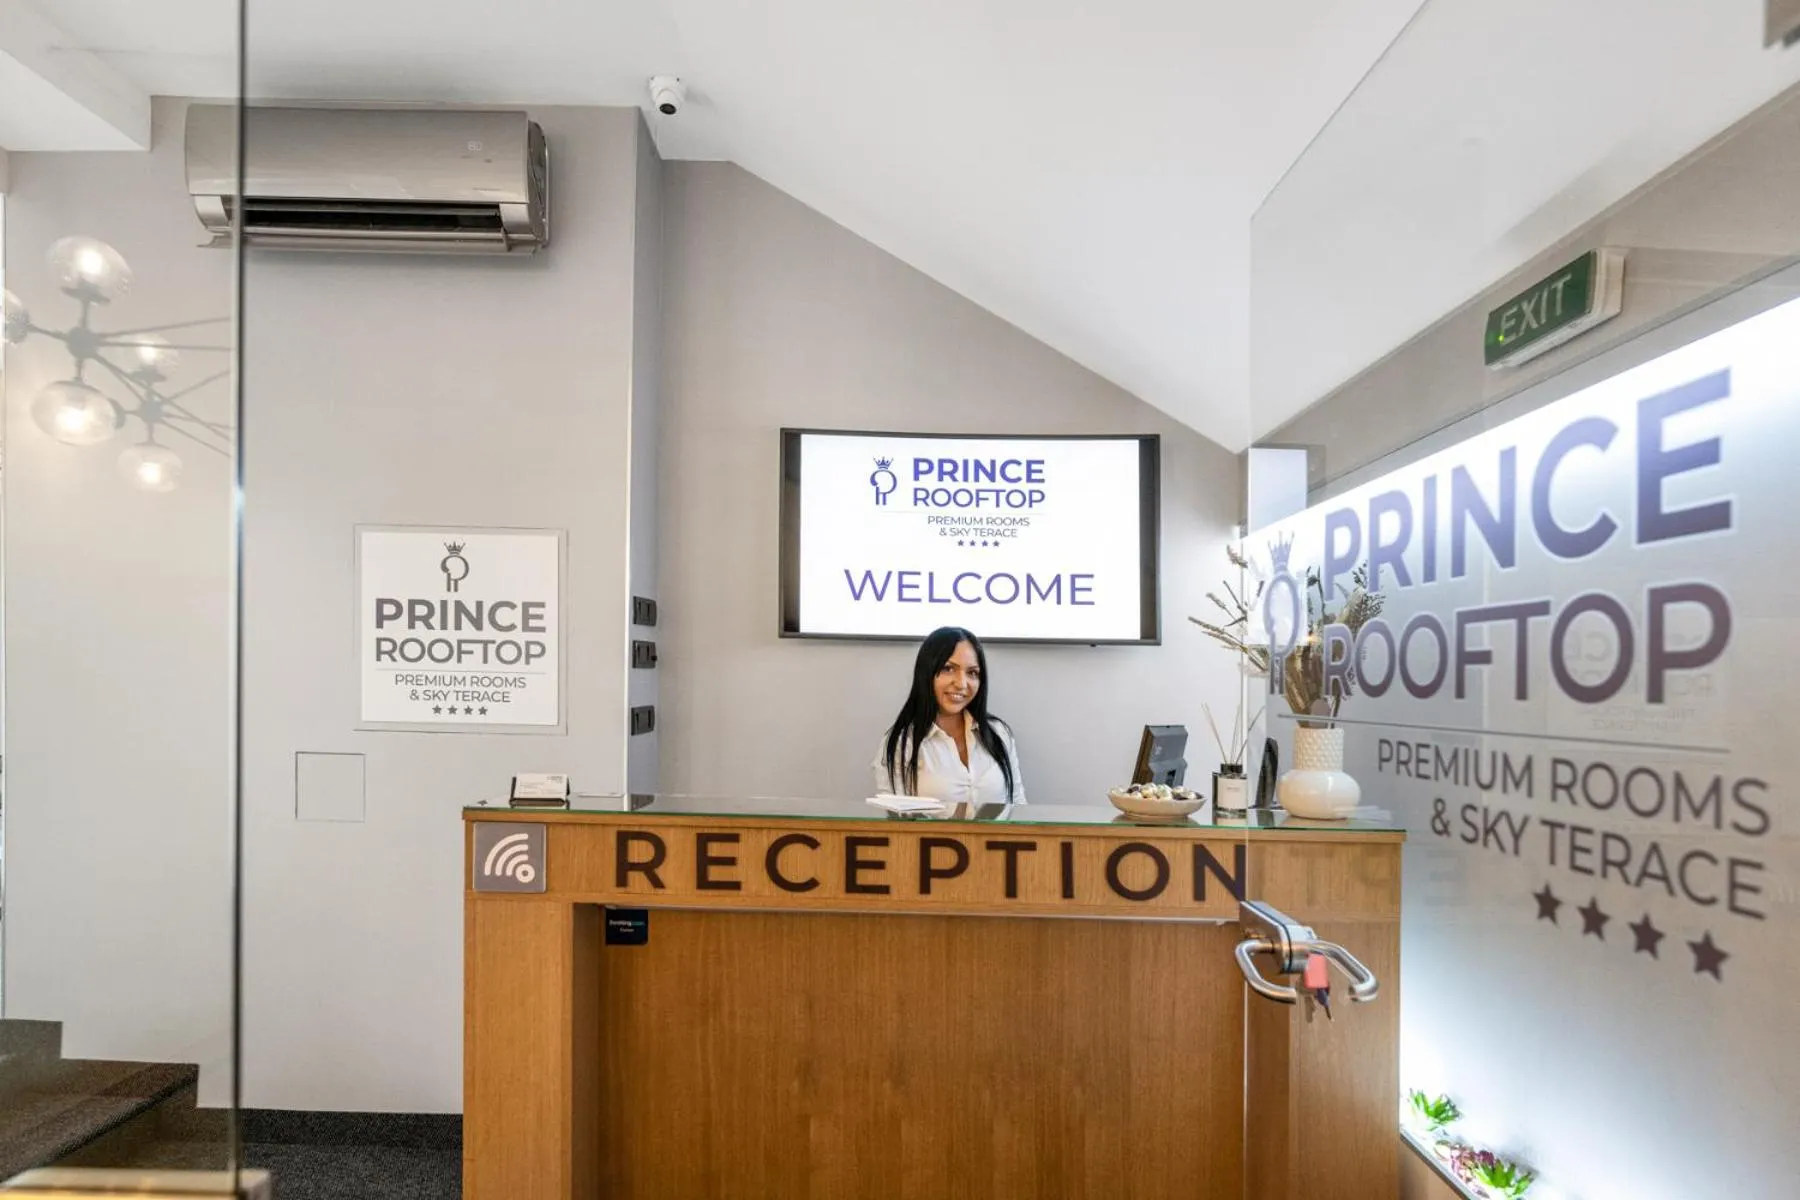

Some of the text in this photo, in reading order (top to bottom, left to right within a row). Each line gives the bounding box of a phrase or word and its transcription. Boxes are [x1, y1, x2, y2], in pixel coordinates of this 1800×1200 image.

[1500, 274, 1572, 345] EXIT
[912, 457, 1045, 484] PRINCE
[1324, 367, 1731, 600] PRINCE
[912, 488, 1046, 508] ROOFTOP
[927, 516, 1030, 527] PREMIUM ROOMS
[939, 527, 1018, 538] & SKY TERACE
[844, 569, 1095, 605] WELCOME
[375, 598, 546, 633] PRINCE
[375, 637, 546, 665] ROOFTOP
[1324, 582, 1732, 704] ROOFTOP
[395, 674, 526, 689] PREMIUM ROOMS
[409, 690, 511, 703] & SKY TERACE
[1378, 738, 1771, 837] PREMIUM ROOMS
[616, 830, 1246, 902] RECEPTION
[1431, 799, 1767, 921] & SKY TERACE
